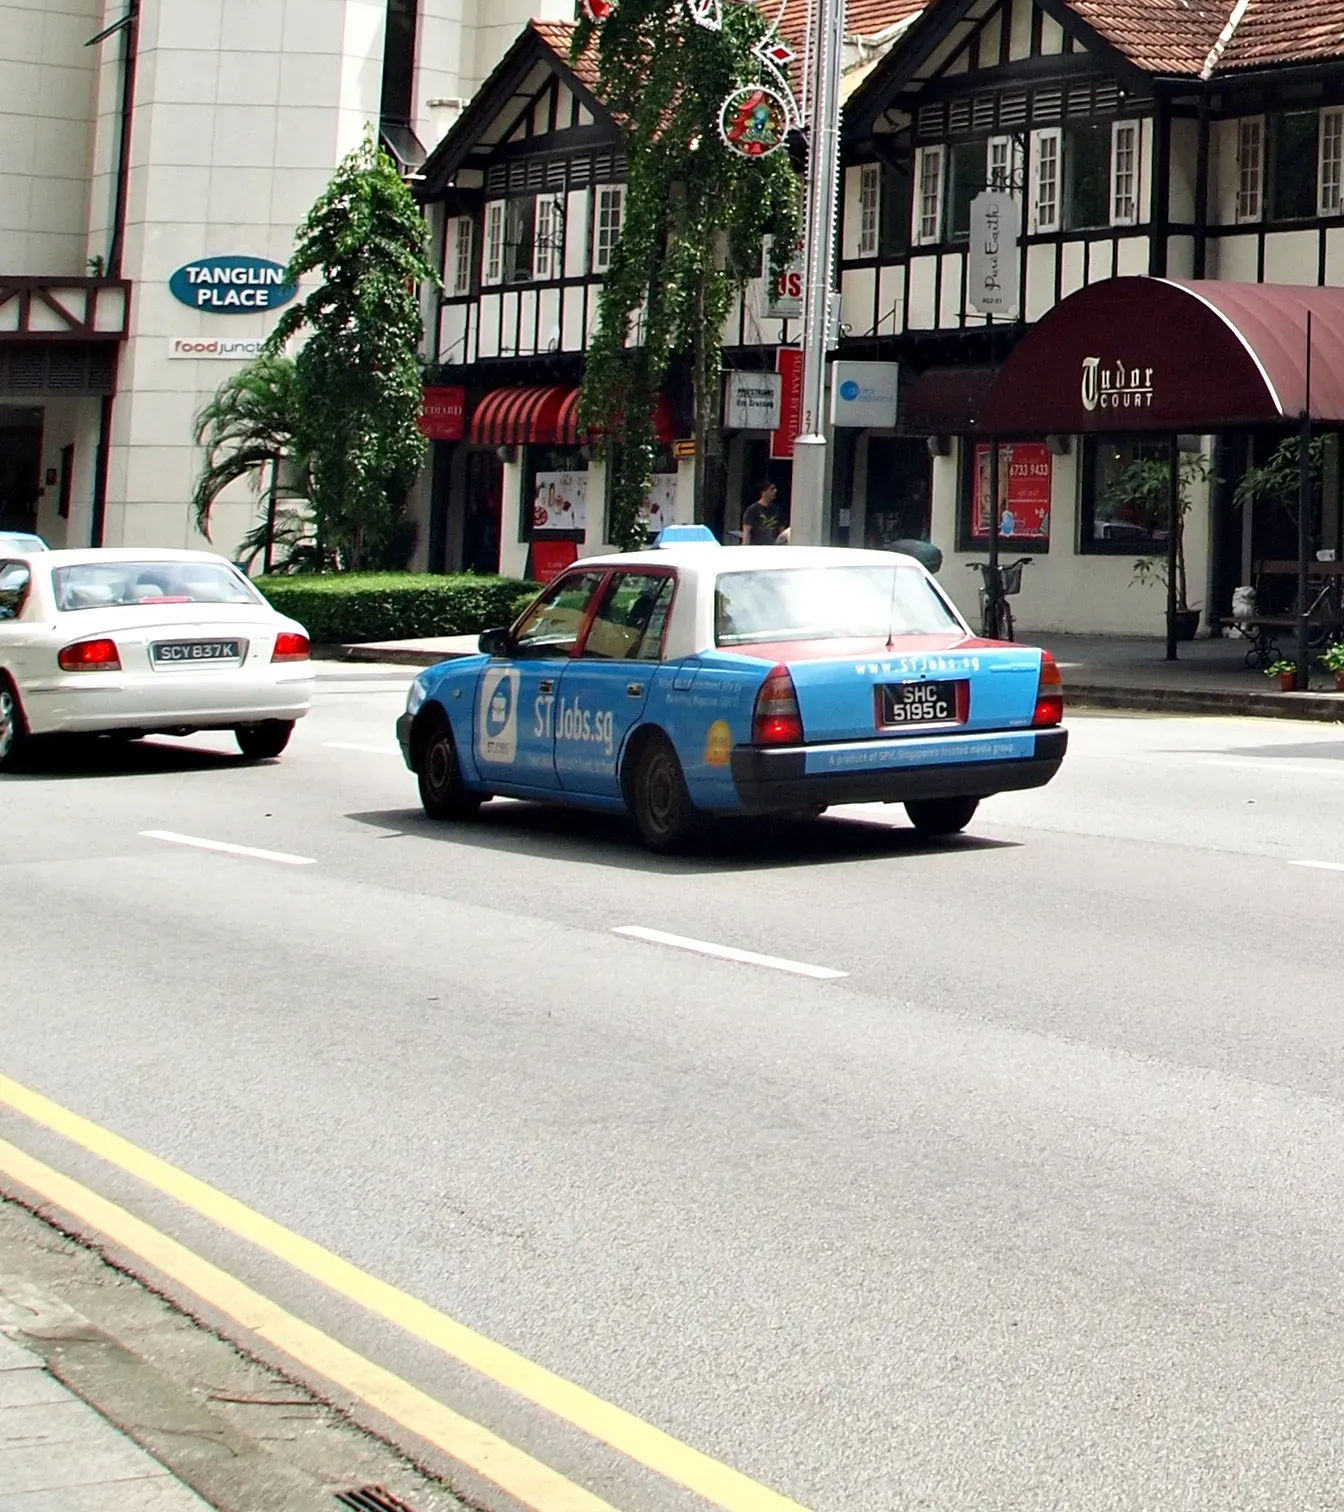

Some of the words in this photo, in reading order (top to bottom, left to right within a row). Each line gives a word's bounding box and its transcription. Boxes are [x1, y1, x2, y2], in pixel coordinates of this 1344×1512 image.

[186, 266, 284, 285] TANGLIN
[197, 289, 269, 306] PLACE
[1082, 356, 1153, 411] Tudor
[1100, 393, 1153, 408] COURT
[903, 685, 938, 703] SHC
